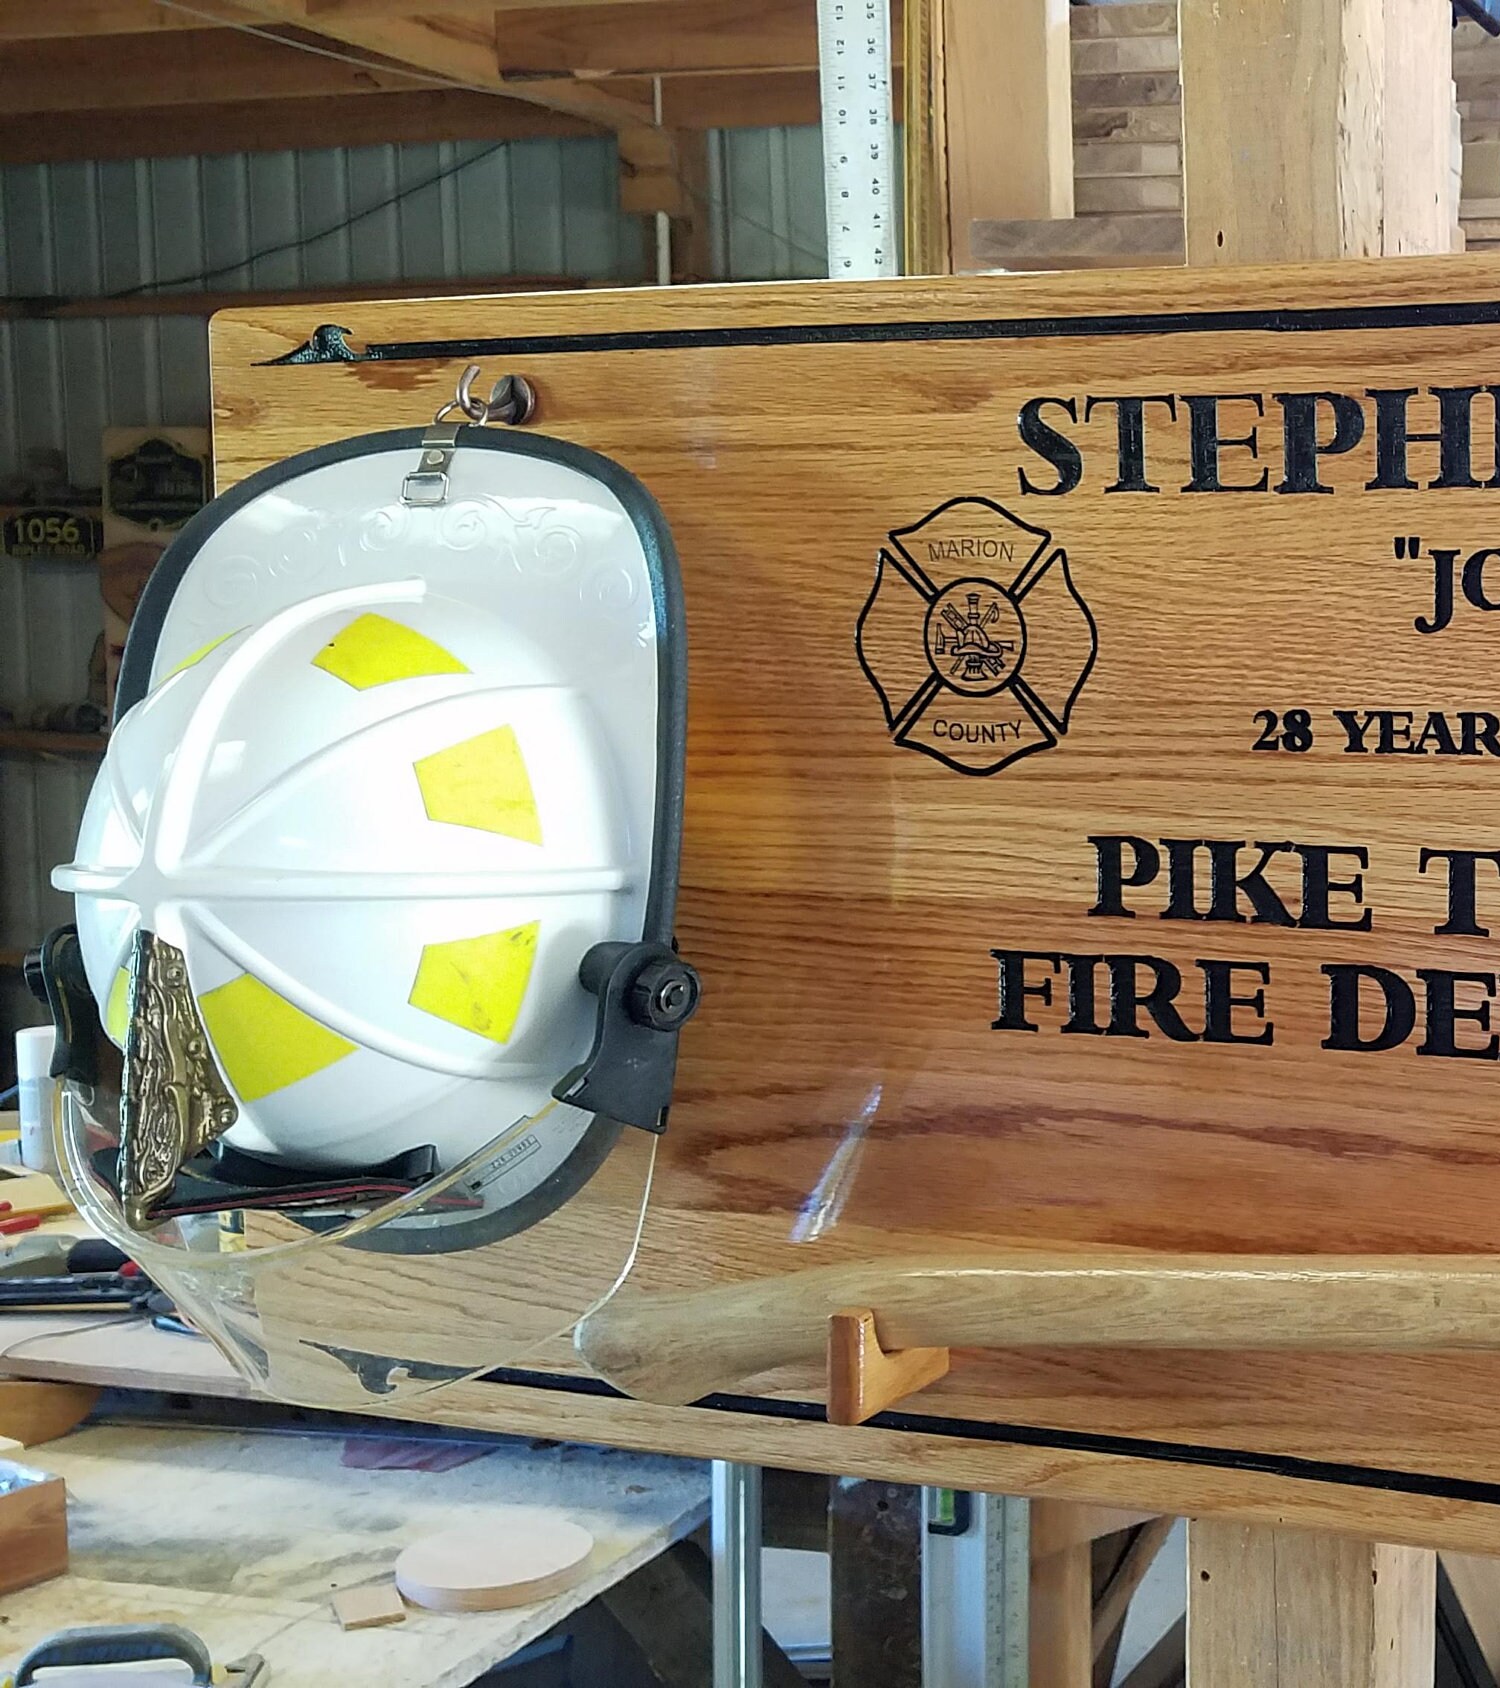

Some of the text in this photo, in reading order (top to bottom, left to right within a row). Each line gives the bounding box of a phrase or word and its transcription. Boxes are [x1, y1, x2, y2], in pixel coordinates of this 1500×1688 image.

[835, 4, 844, 21] 13
[866, 2, 875, 20] 35
[836, 39, 845, 55] 12
[867, 38, 876, 55] 36
[837, 75, 846, 91] 11
[868, 73, 877, 90] 37
[838, 109, 847, 125] 10
[869, 108, 878, 125] 38
[870, 143, 879, 160] 39
[872, 178, 880, 195] 40
[873, 213, 881, 229] 41
[874, 247, 883, 265] 42
[14, 517, 80, 544] 1056
[928, 538, 1014, 562] MARION
[932, 719, 1022, 744] COUNTY
[1253, 709, 1313, 752] 28
[1088, 836, 1373, 932] PIKE
[990, 949, 1273, 1046] FIRE
